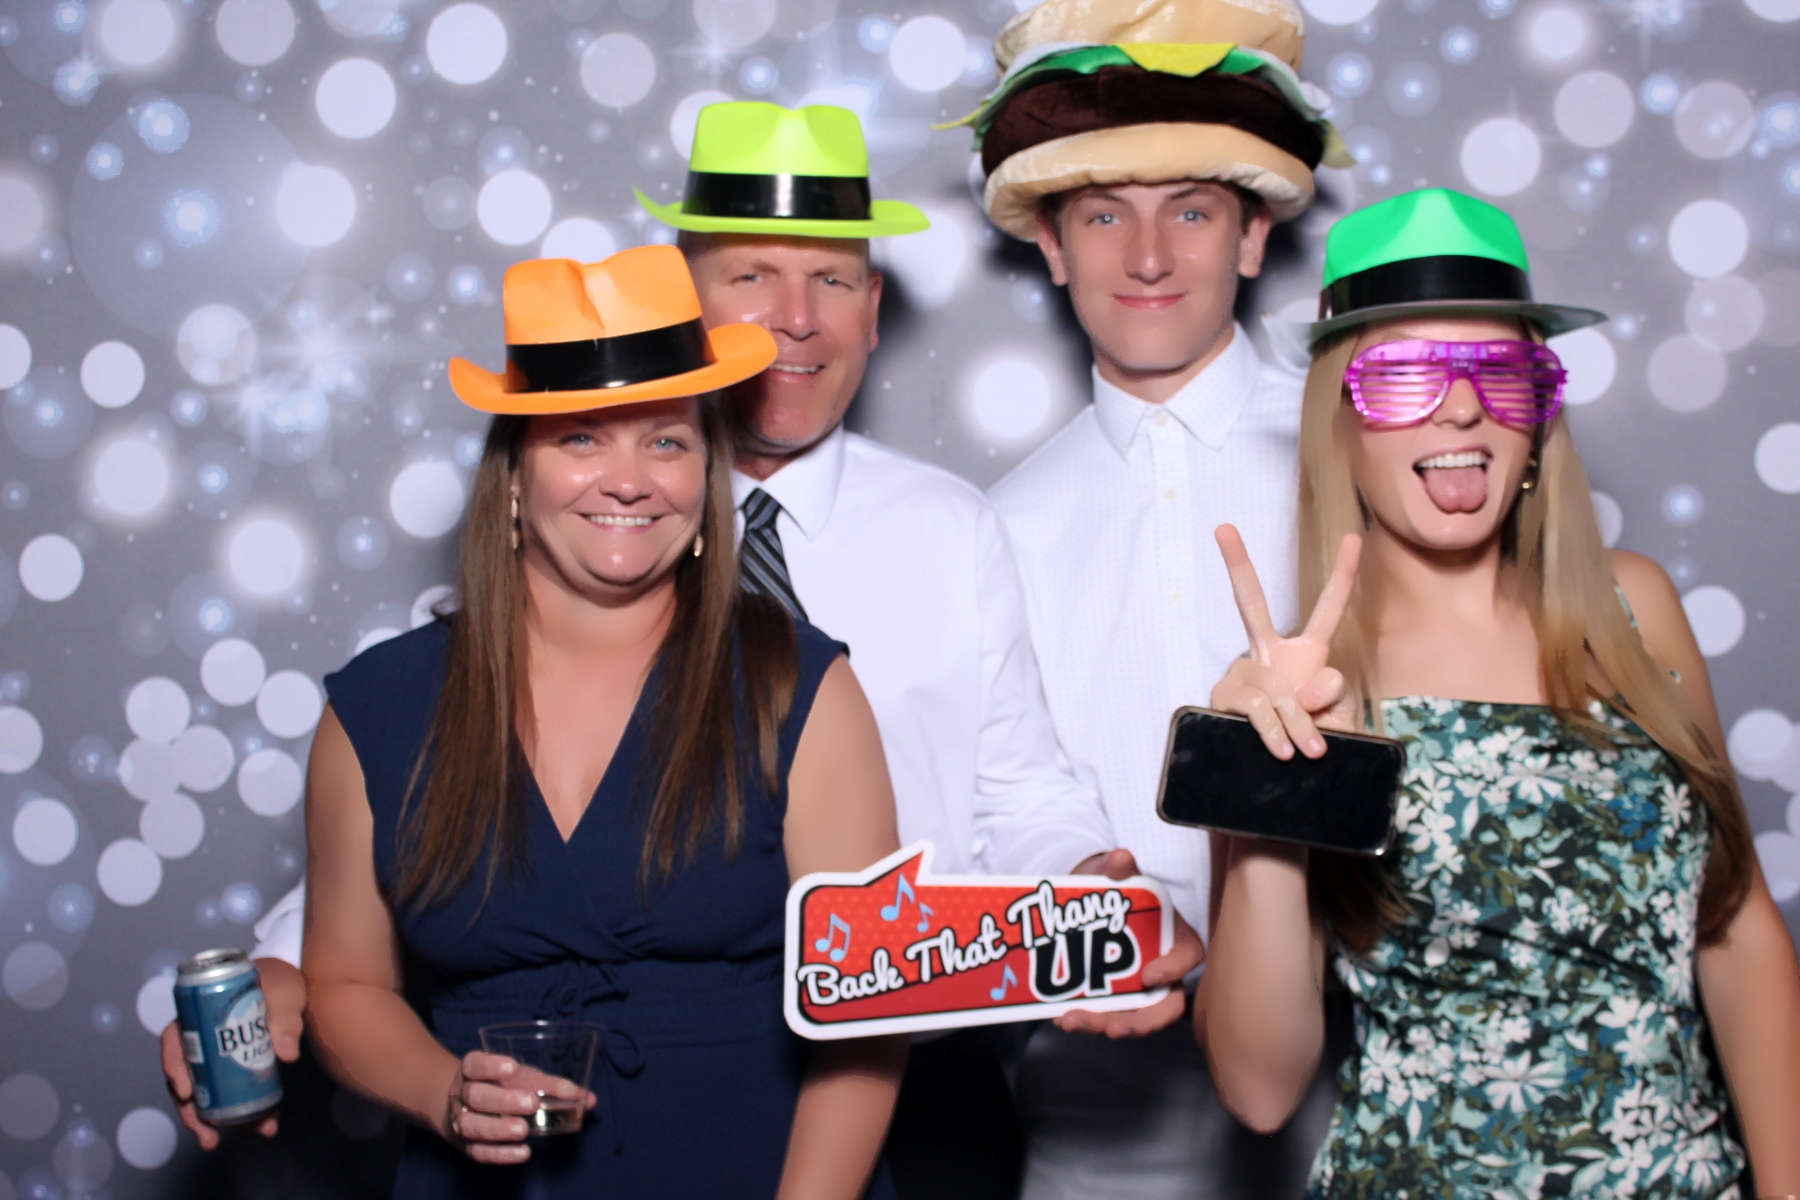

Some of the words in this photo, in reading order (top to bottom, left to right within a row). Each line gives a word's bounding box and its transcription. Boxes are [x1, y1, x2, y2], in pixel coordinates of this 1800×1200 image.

[797, 948, 904, 1005] Back
[906, 913, 1006, 983] That
[1007, 880, 1131, 949] Thang
[1030, 921, 1140, 1002] UP
[219, 1017, 270, 1052] BUS
